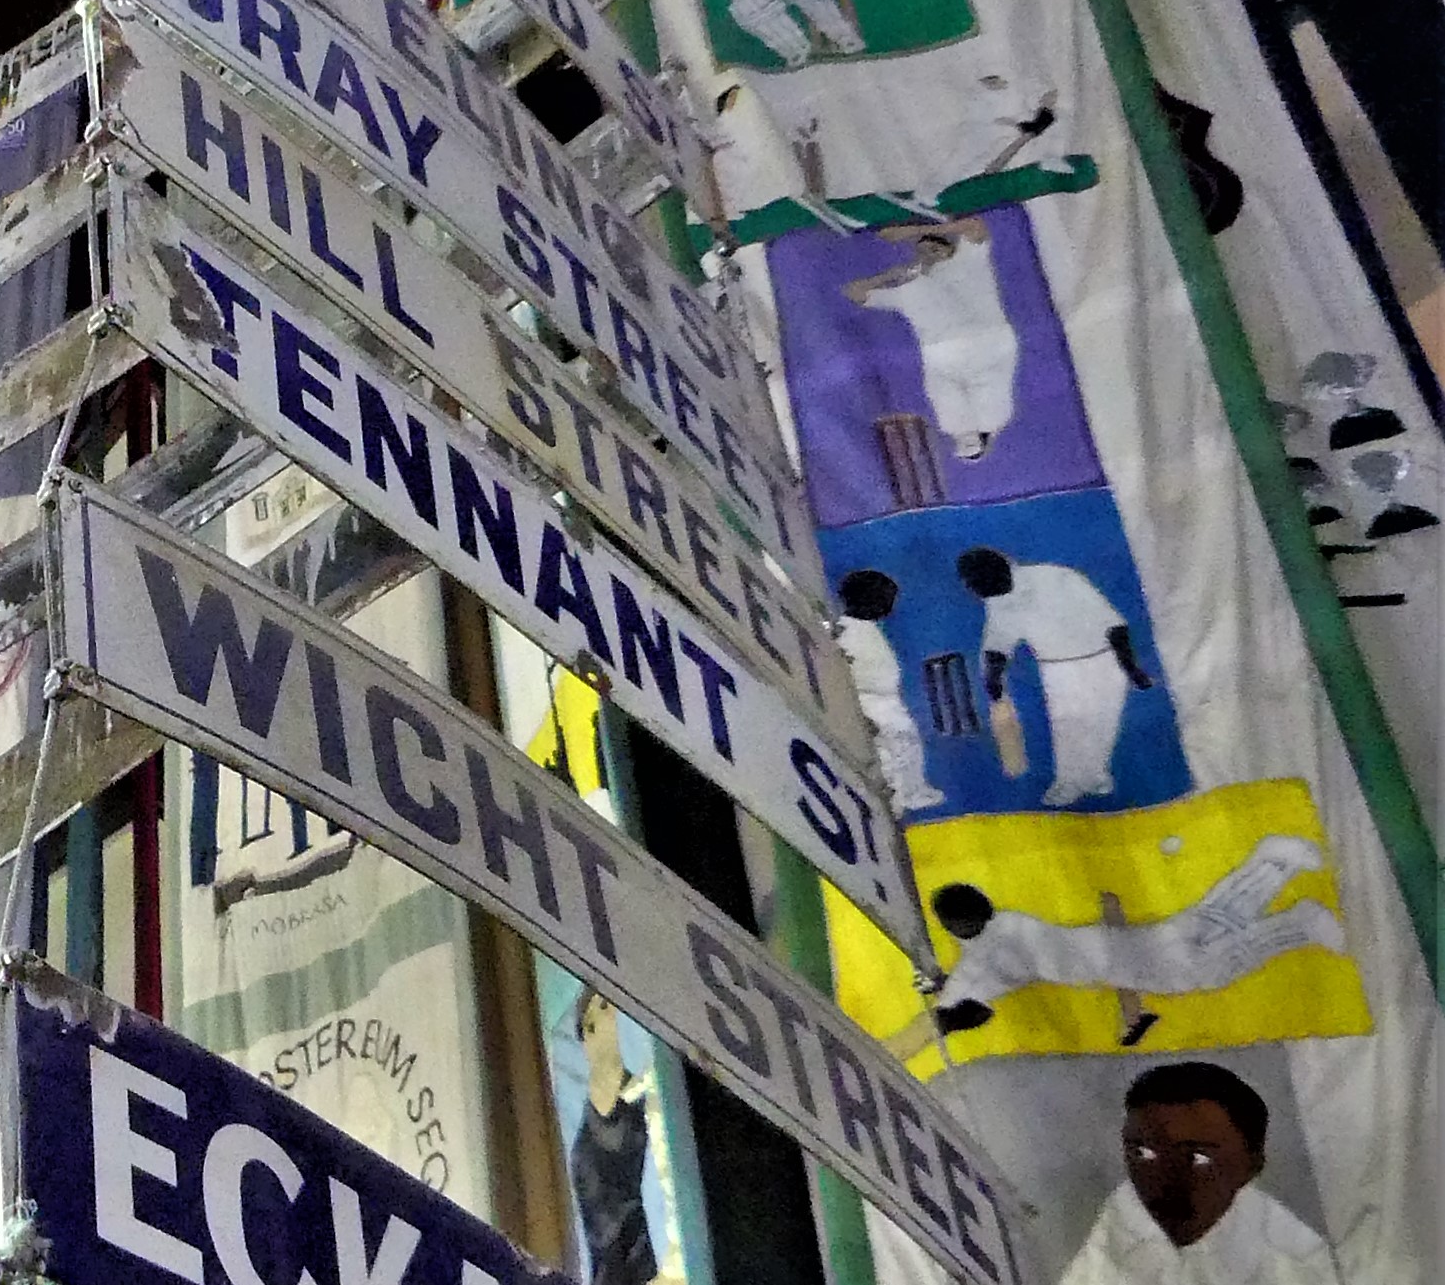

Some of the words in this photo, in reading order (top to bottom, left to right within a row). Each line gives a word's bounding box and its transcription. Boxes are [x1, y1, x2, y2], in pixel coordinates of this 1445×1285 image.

[178, 239, 737, 765] TENNANT
[179, 70, 435, 349] HILL
[485, 313, 828, 716] STREET
[497, 185, 795, 556] STREET
[135, 545, 621, 968] WICHT
